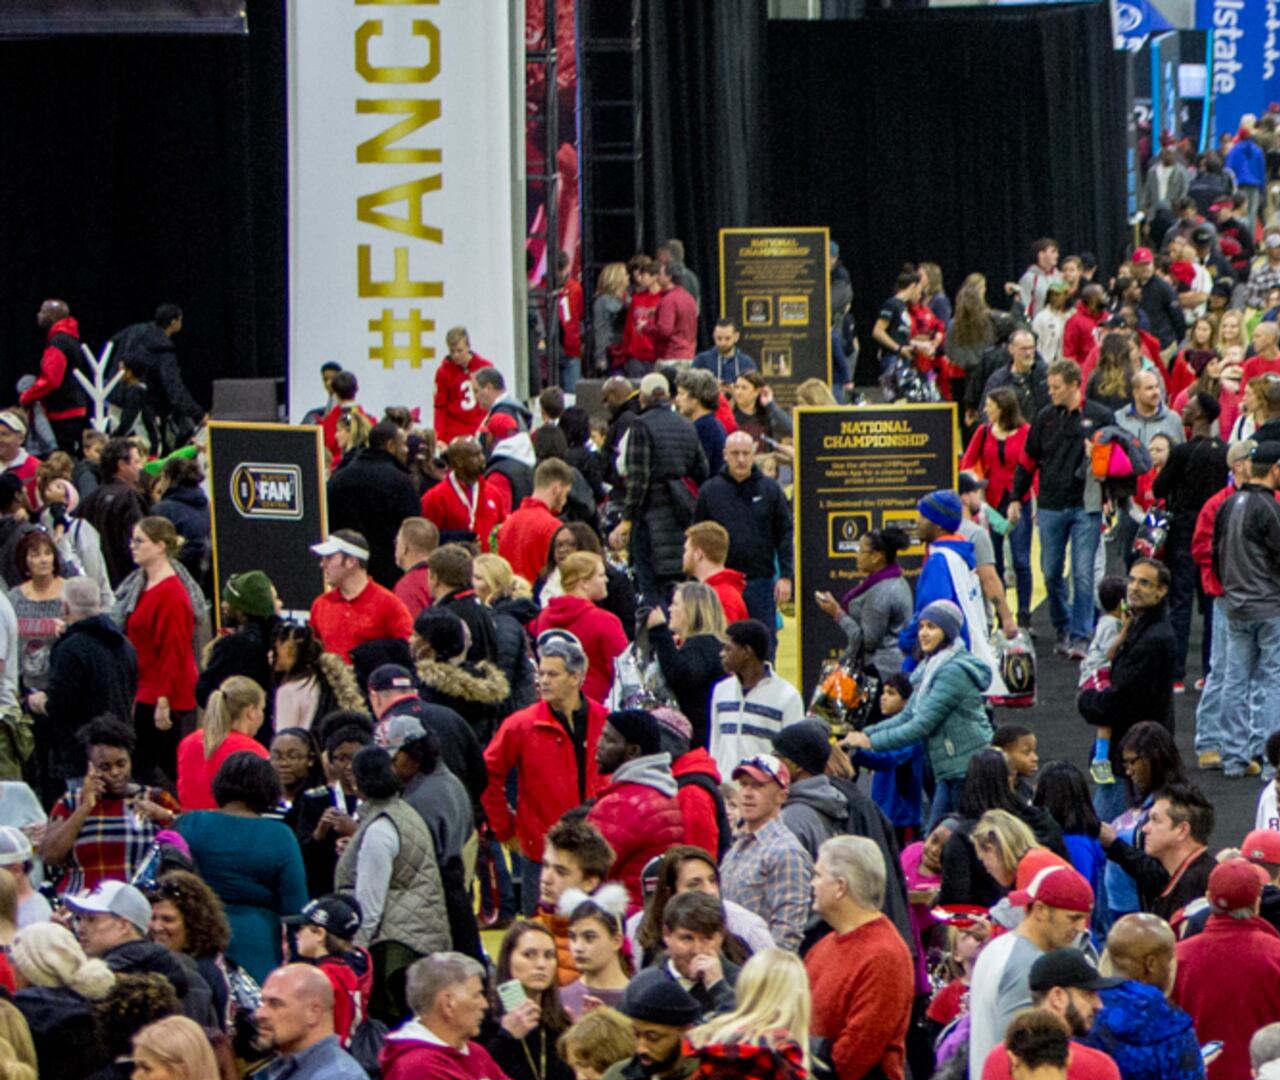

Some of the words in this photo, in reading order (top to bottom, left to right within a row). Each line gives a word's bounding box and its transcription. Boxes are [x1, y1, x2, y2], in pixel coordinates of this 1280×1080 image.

[356, 0, 443, 369] #FANC
[841, 421, 911, 434] NATIONAL
[823, 433, 930, 448] CHAMPIONSHIP
[260, 481, 291, 502] FAN
